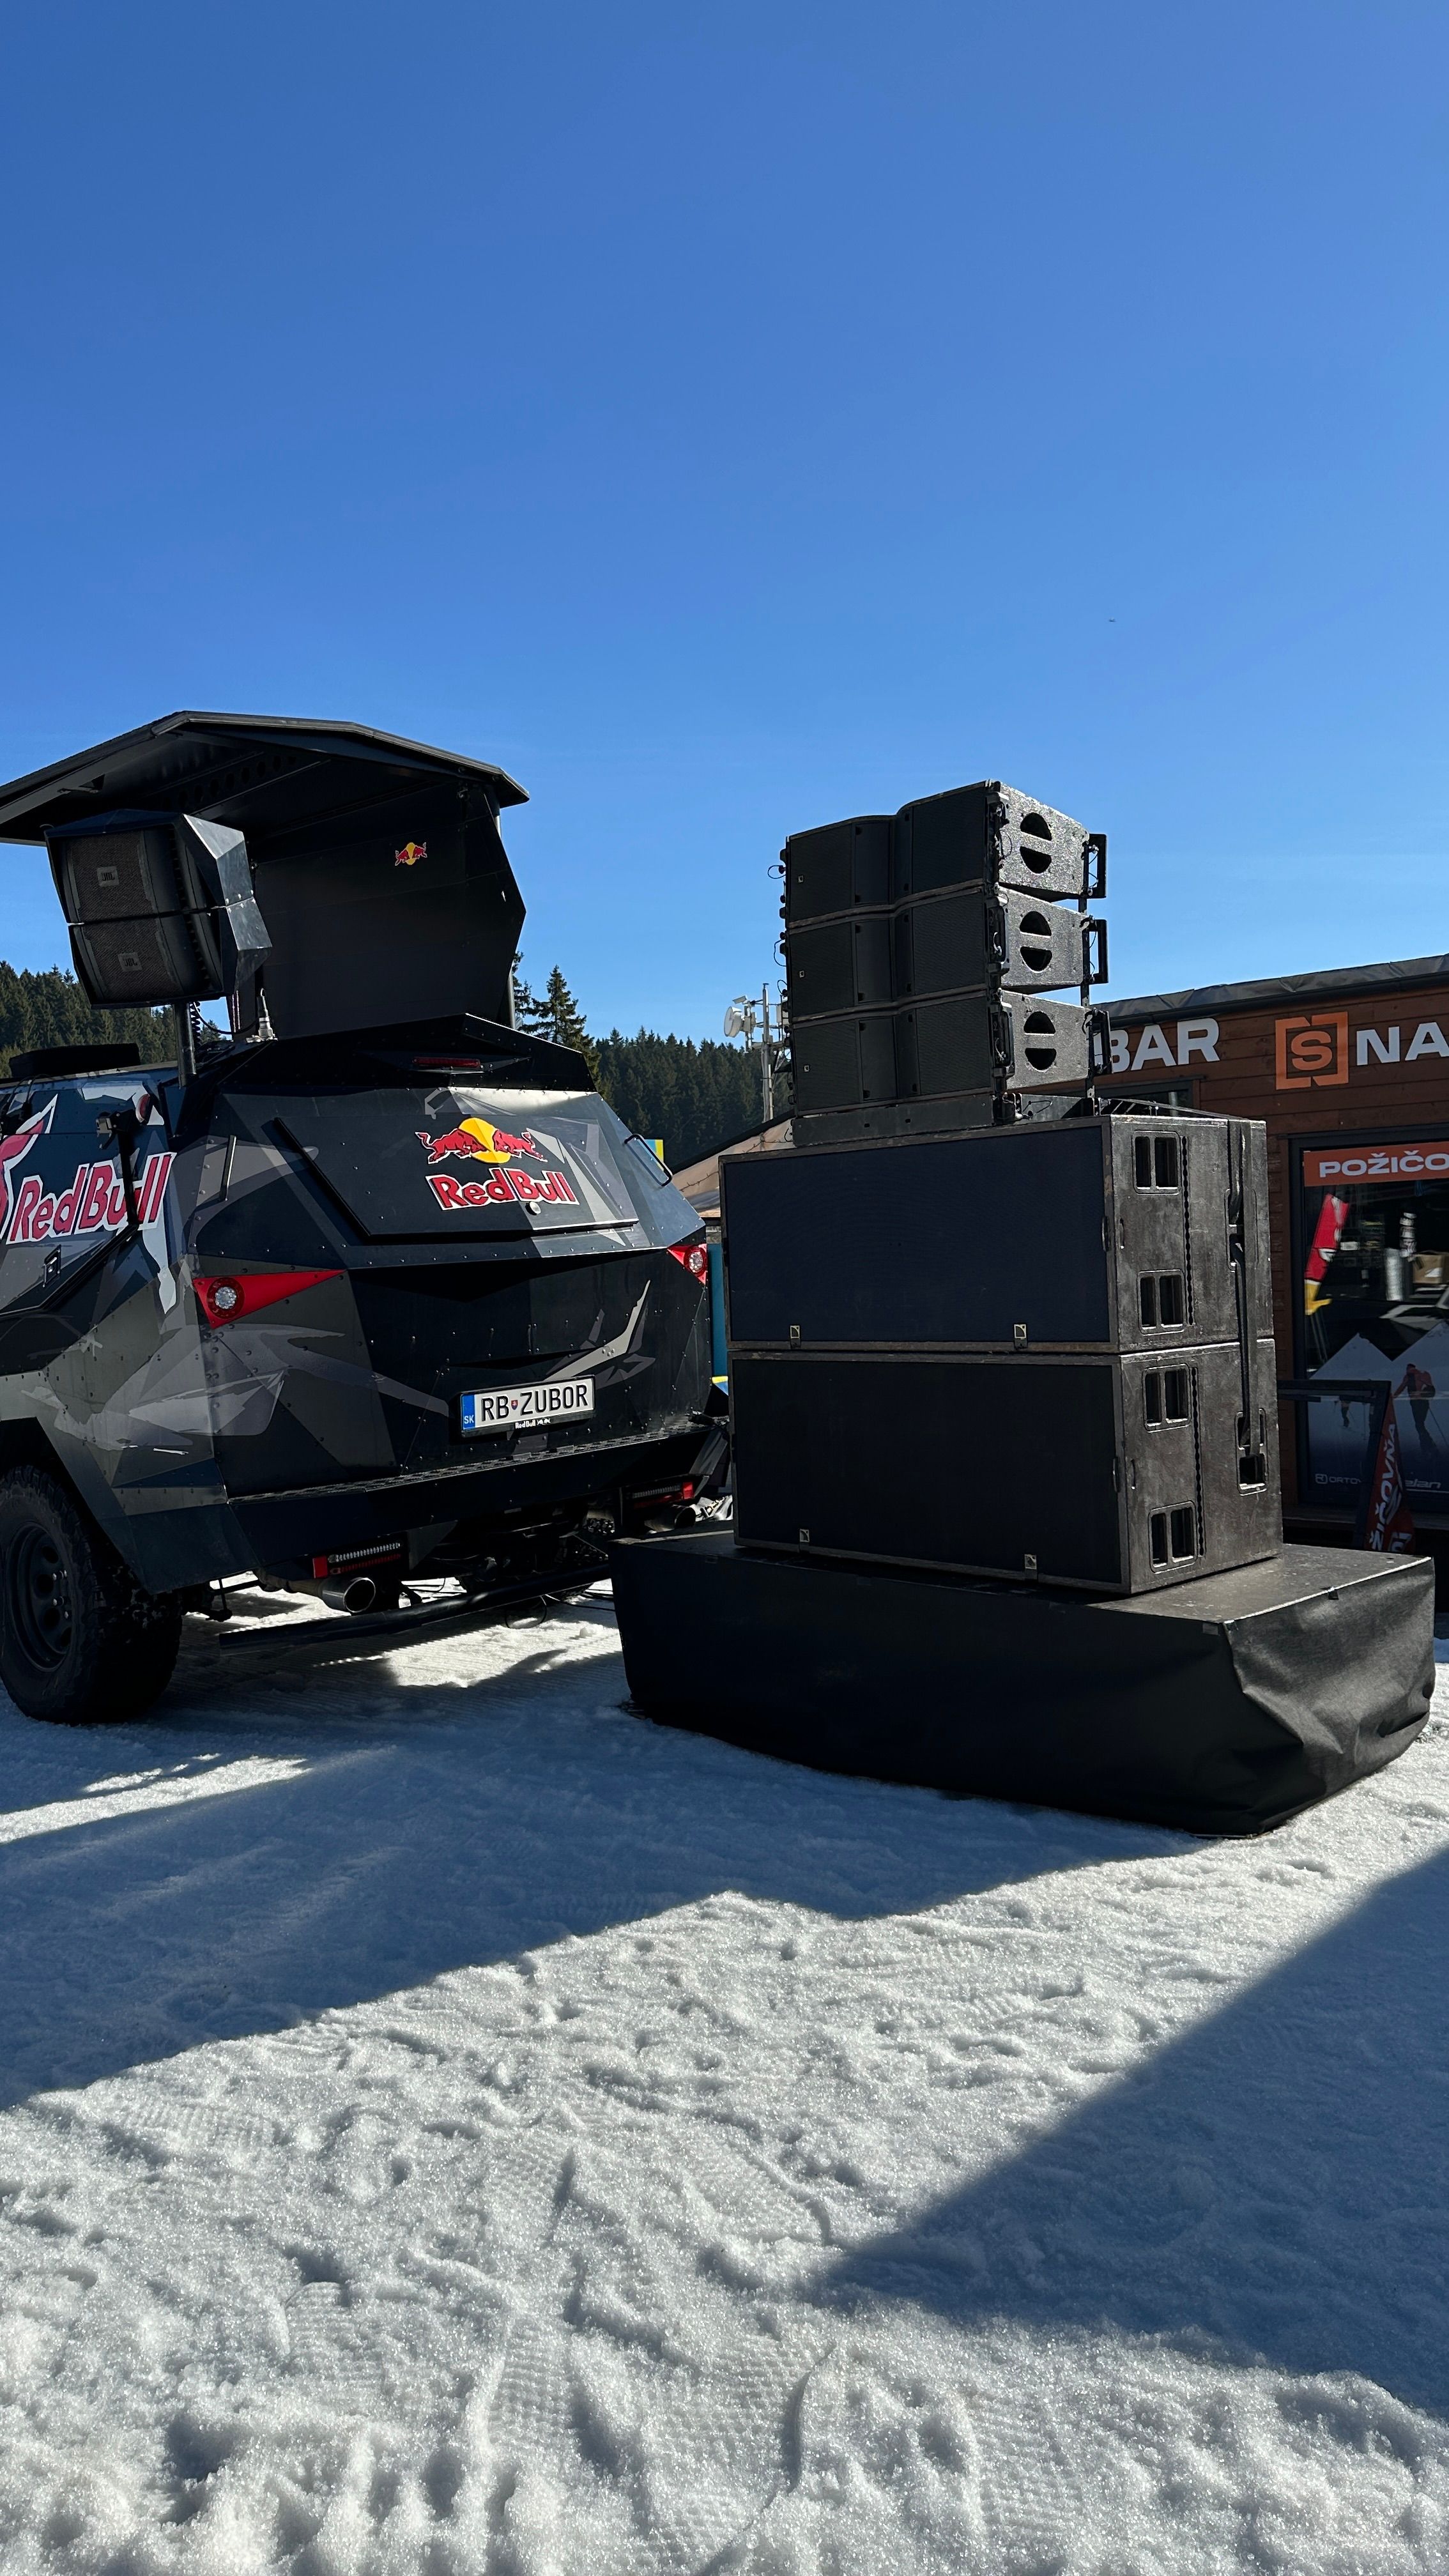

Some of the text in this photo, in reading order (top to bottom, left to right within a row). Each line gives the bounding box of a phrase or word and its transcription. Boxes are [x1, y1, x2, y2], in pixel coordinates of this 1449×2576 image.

[1092, 1017, 1220, 1074] BAR
[1356, 1022, 1449, 1066] NA
[1319, 1149, 1449, 1178] POŽIČO
[463, 1414, 475, 1425] SK
[480, 1383, 588, 1422] RB ZUBOR
